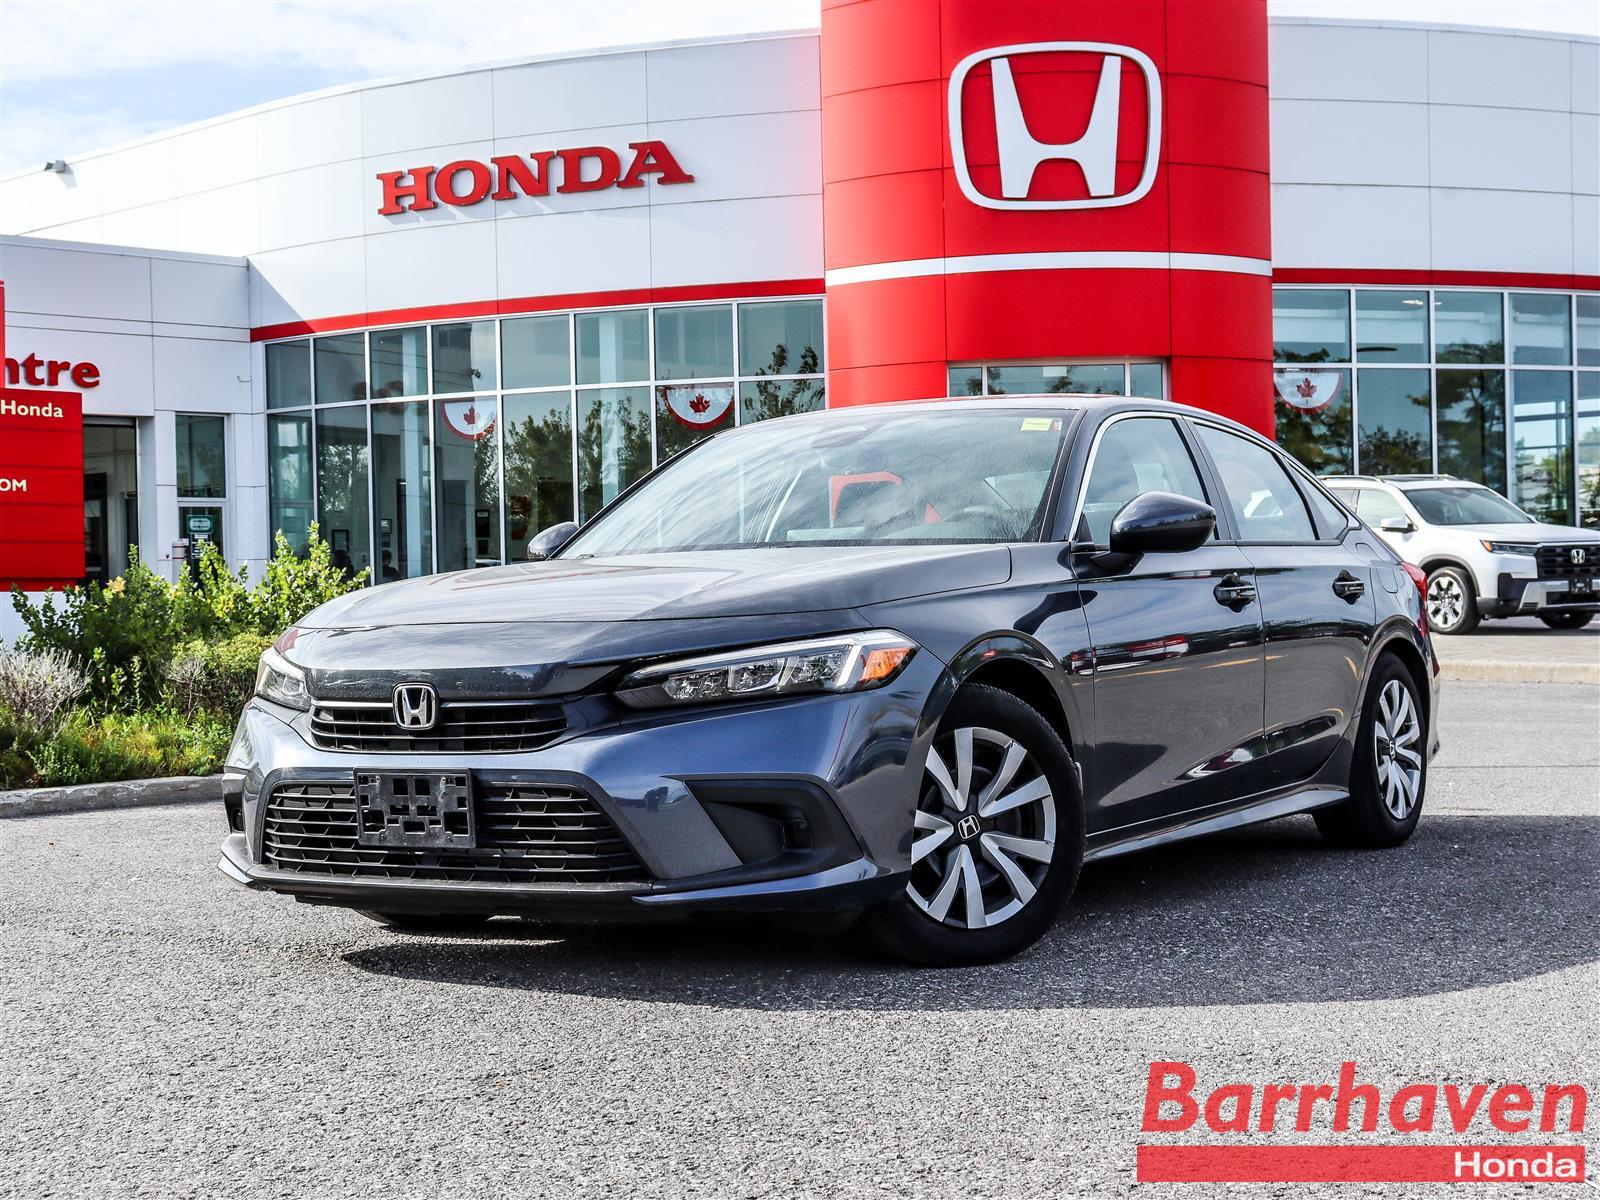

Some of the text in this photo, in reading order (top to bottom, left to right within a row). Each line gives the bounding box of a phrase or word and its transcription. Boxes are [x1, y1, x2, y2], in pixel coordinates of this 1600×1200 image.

[990, 54, 1122, 199] H
[376, 140, 695, 216] HONDA
[1, 399, 63, 418] Honda
[0, 478, 27, 492] OM
